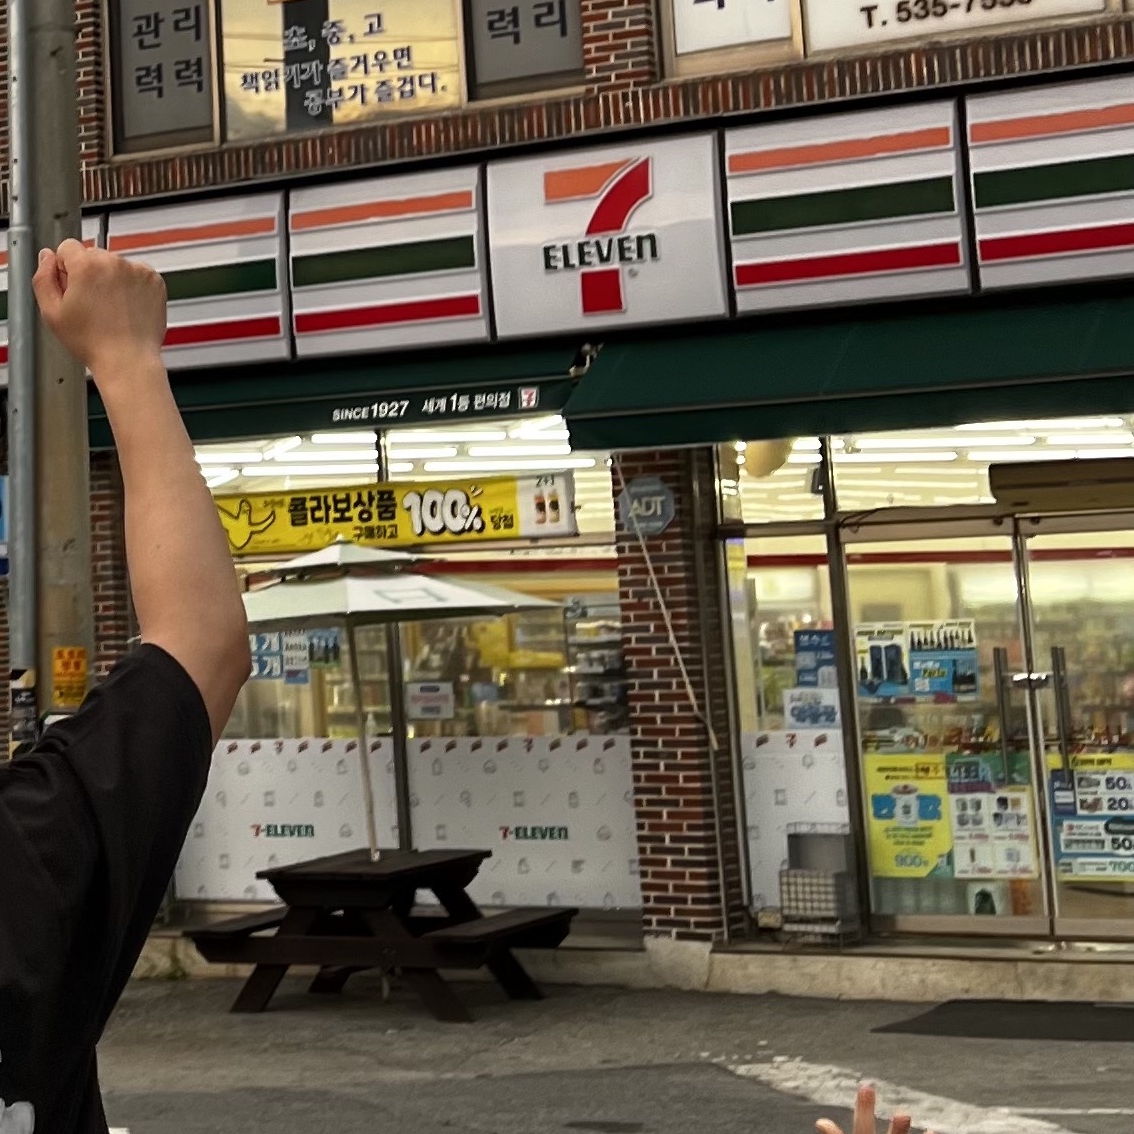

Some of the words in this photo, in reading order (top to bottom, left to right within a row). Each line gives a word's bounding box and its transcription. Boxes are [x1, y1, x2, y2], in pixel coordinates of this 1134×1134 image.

[364, 12, 384, 37] 고
[327, 46, 412, 80] 즐거우면
[371, 400, 410, 418] 1927
[422, 396, 447, 414] 세계
[474, 390, 511, 410] 편의점
[288, 489, 397, 527] 콜라보상품
[402, 488, 486, 536] 100%
[628, 495, 666, 517] ADT
